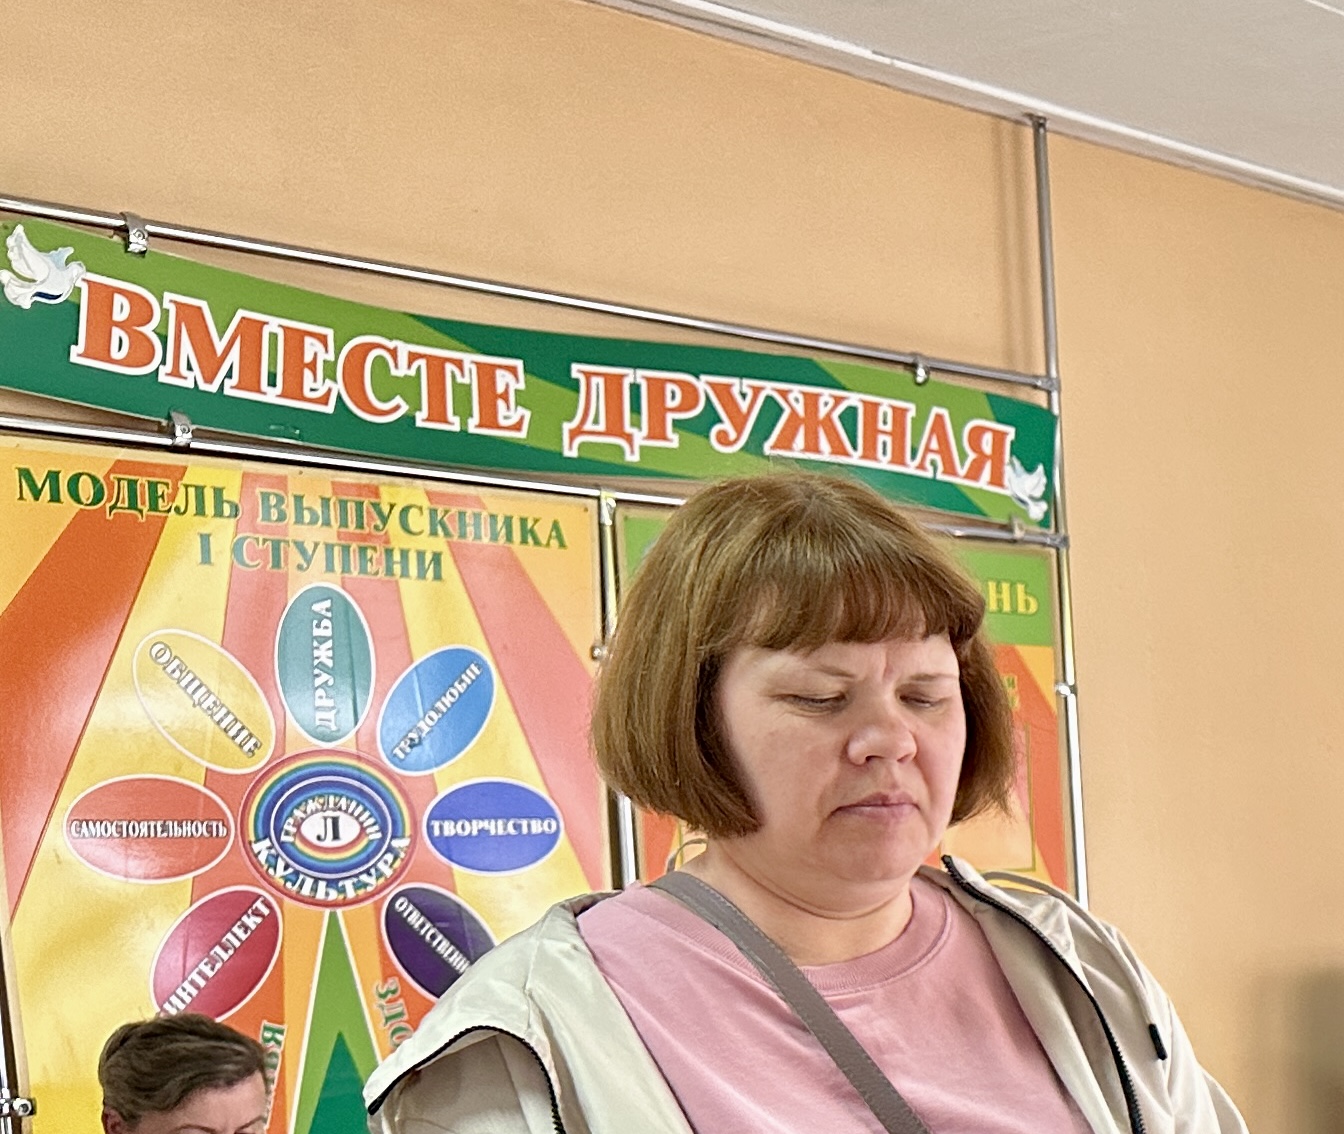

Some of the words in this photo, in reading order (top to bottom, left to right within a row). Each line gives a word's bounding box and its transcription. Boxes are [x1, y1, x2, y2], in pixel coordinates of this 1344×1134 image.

[69, 275, 529, 440] ВМЕСТЕ
[563, 361, 1016, 494] ДРУЖНАЯ
[16, 466, 241, 522] МОДЕЛЬ
[259, 488, 569, 550] ВЫПУСКНИКА
[230, 533, 445, 583] СТУПЕНИ
[149, 641, 263, 758] ОБЩЕНИЕ
[311, 598, 341, 732] ДРУЖБА
[392, 660, 484, 760] ТРУДОЛЮБИЕ
[70, 819, 228, 839] САМОСТОЯТЕЛЬНОСТЬ
[250, 838, 411, 901] КУЛЬТУРА
[430, 818, 557, 837] ТВОРЧЕСТВО
[160, 895, 270, 1016] ИНТЕЛЛЕКТ
